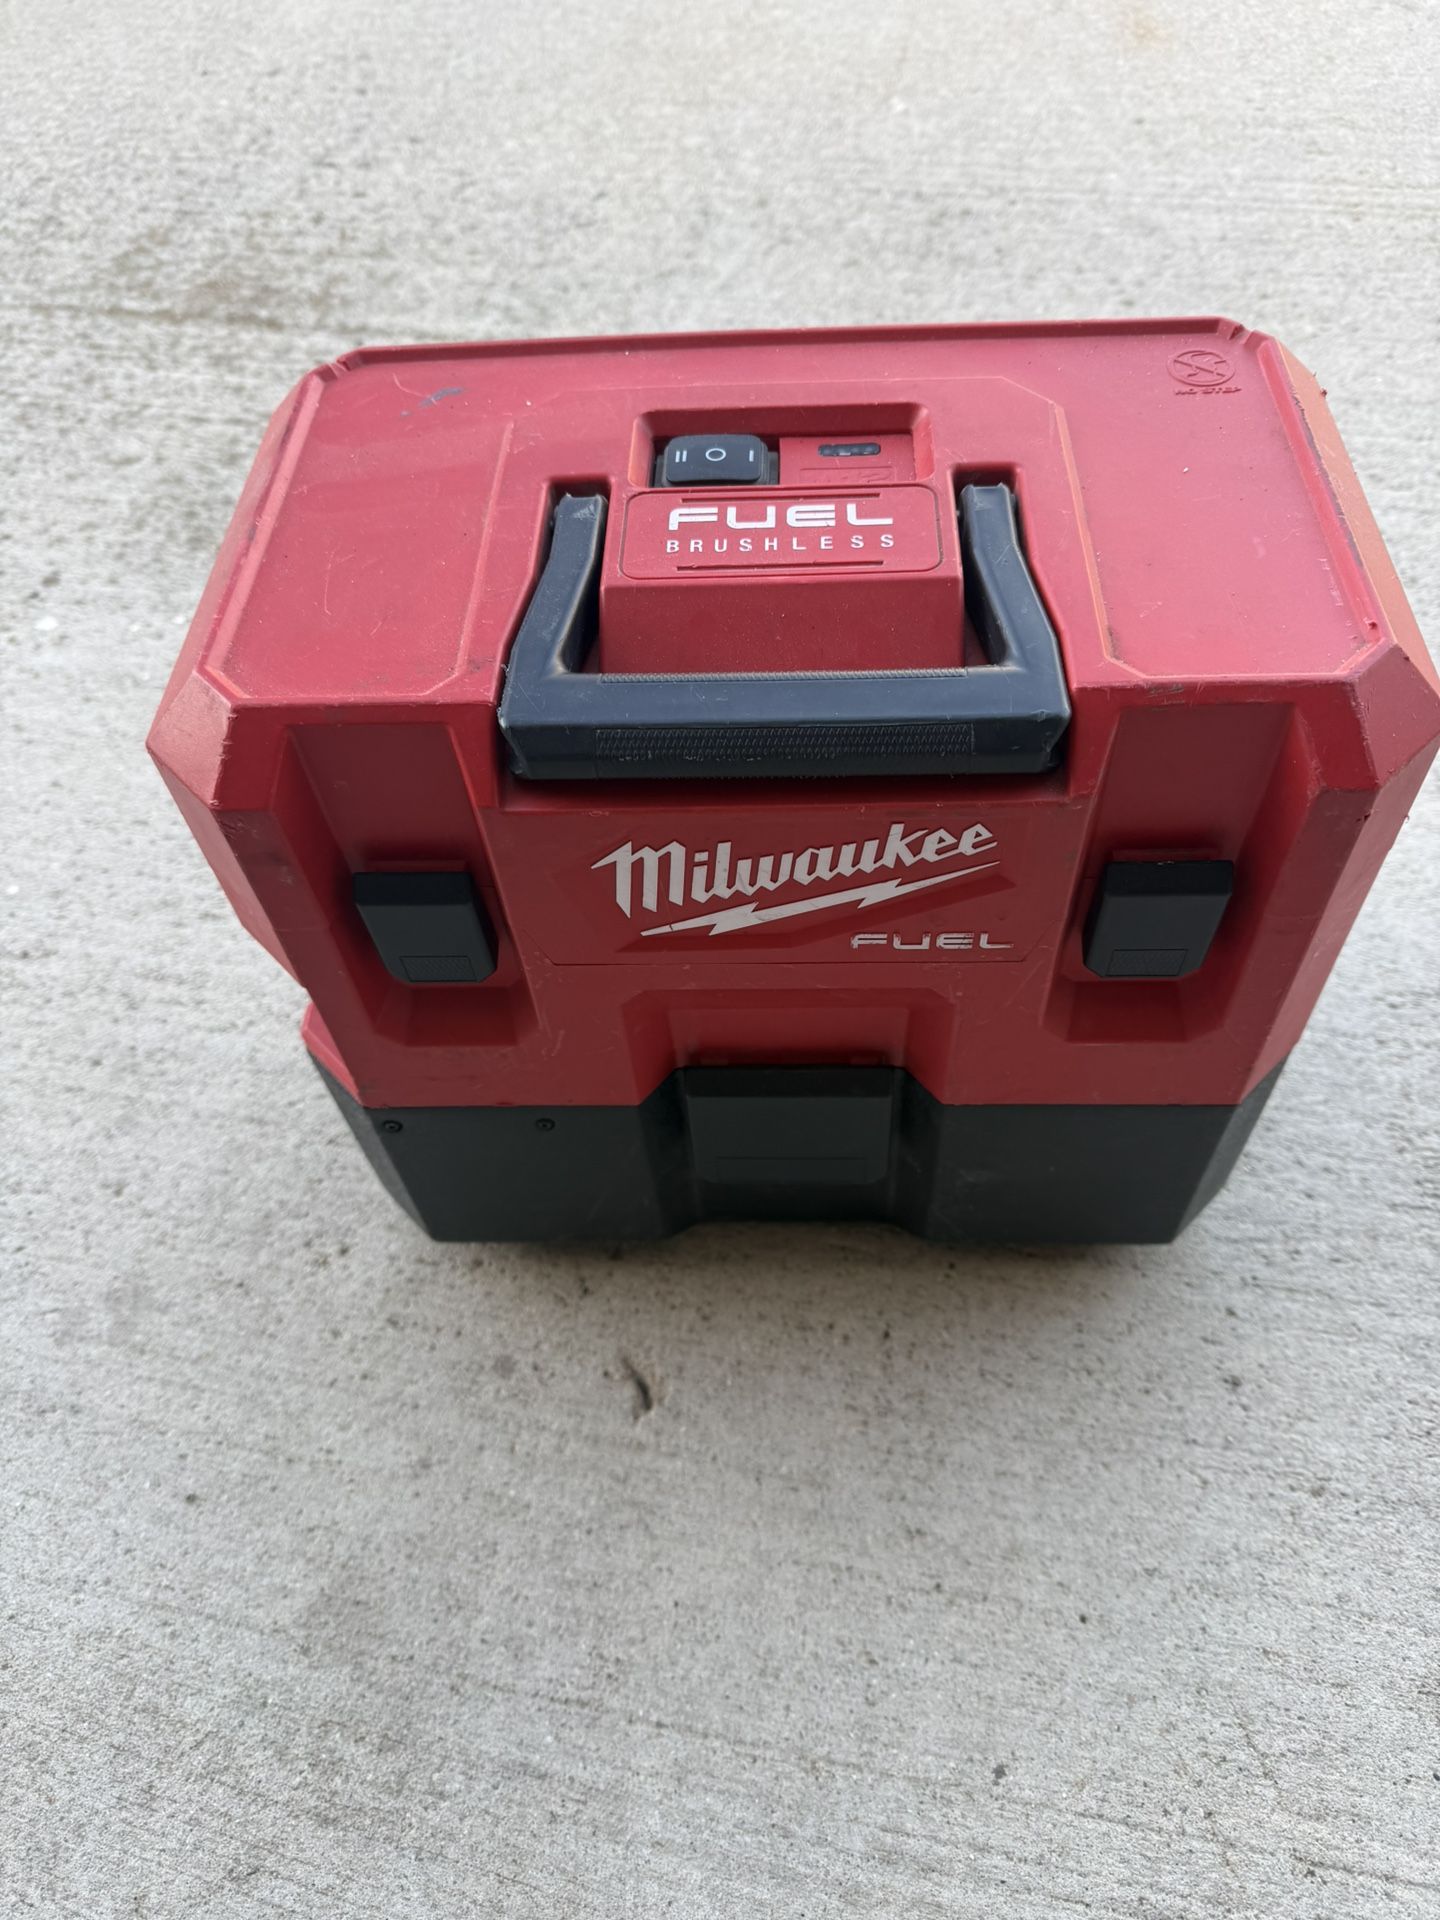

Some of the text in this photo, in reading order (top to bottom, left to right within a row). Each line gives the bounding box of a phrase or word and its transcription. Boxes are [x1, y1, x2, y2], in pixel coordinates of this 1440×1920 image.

[668, 503, 894, 531] FUEL
[666, 534, 894, 554] BRUSHLESS
[591, 823, 998, 919] Milwaukee
[850, 932, 1014, 950] FUEL
